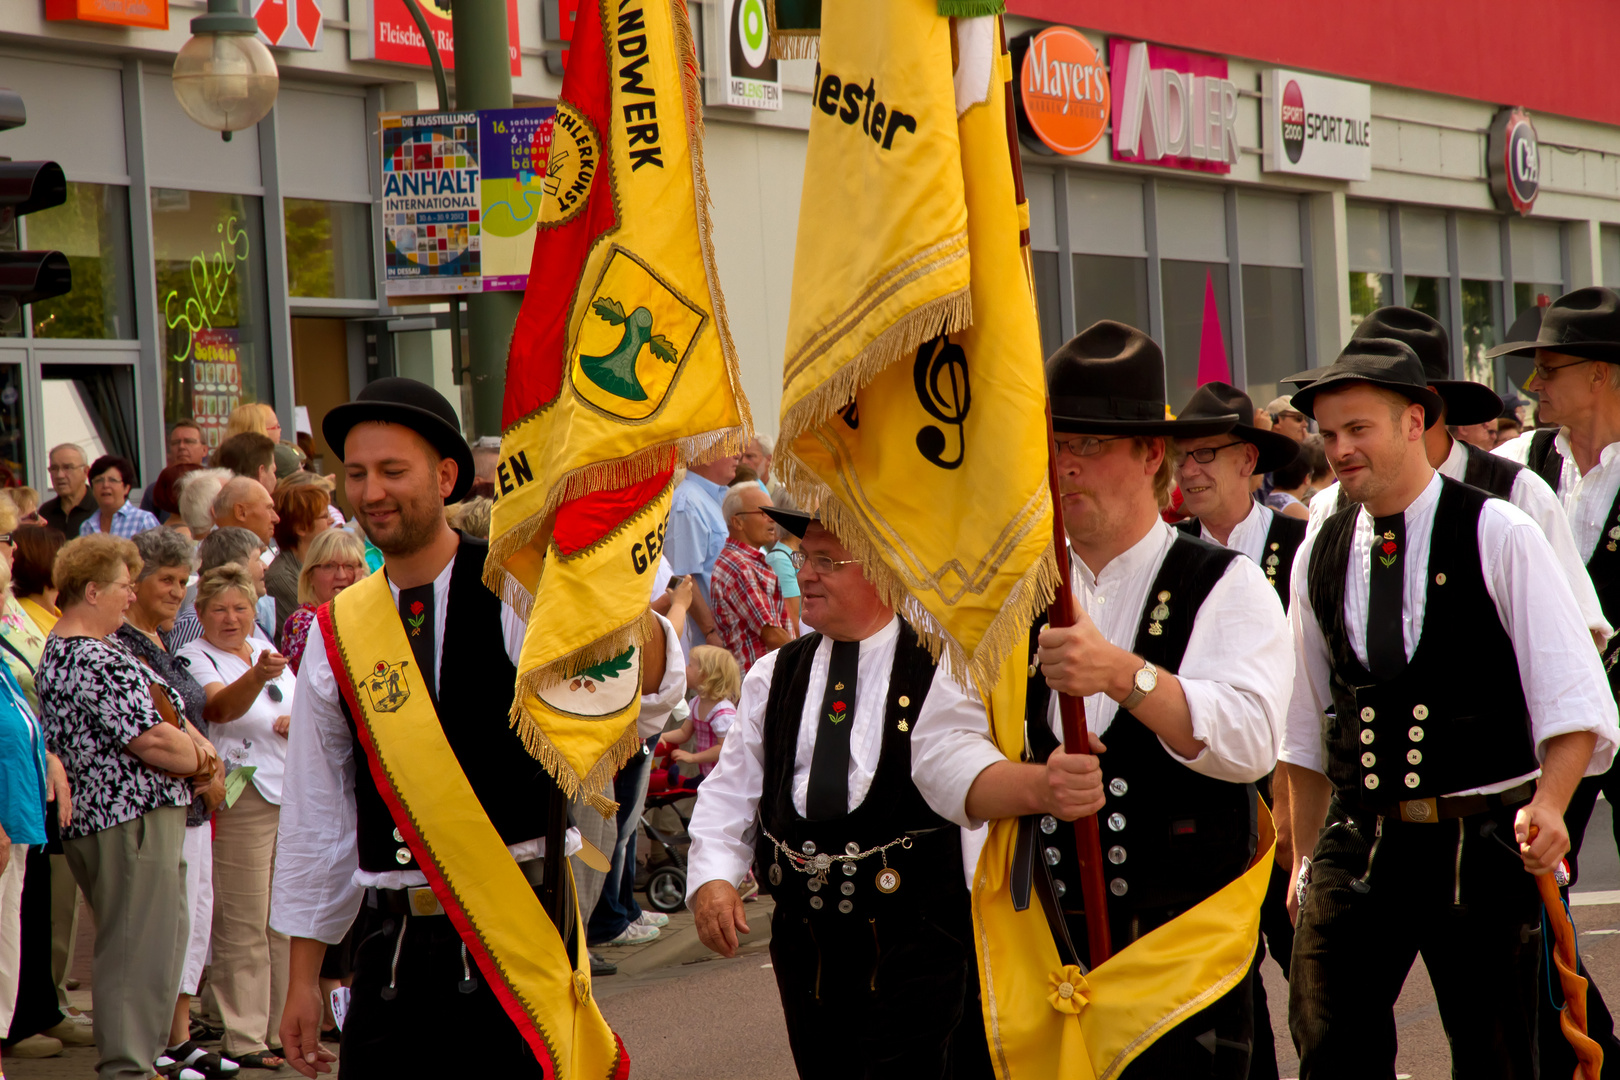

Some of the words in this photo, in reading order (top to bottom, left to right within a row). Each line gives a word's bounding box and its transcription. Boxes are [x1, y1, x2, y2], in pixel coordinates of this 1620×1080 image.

[437, 30, 454, 52] Ric
[731, 81, 779, 100] MEILENSTEIN
[1117, 42, 1241, 164] ADLER
[402, 116, 414, 127] DIE
[416, 113, 476, 126] AUSSTELLUNG
[510, 117, 554, 126] sachsen-a
[1282, 105, 1304, 122] SPORT
[492, 121, 508, 134] 16.
[1284, 124, 1302, 141] 2000
[1306, 112, 1342, 143] SPORT
[1345, 118, 1370, 147] ZILLE
[1516, 137, 1538, 182] C&A
[384, 170, 479, 197] ANHALT
[386, 197, 477, 211] INTERNATIONAL
[397, 267, 421, 275] DESSAU
[165, 216, 249, 362] Softeis
[493, 450, 534, 504] EN
